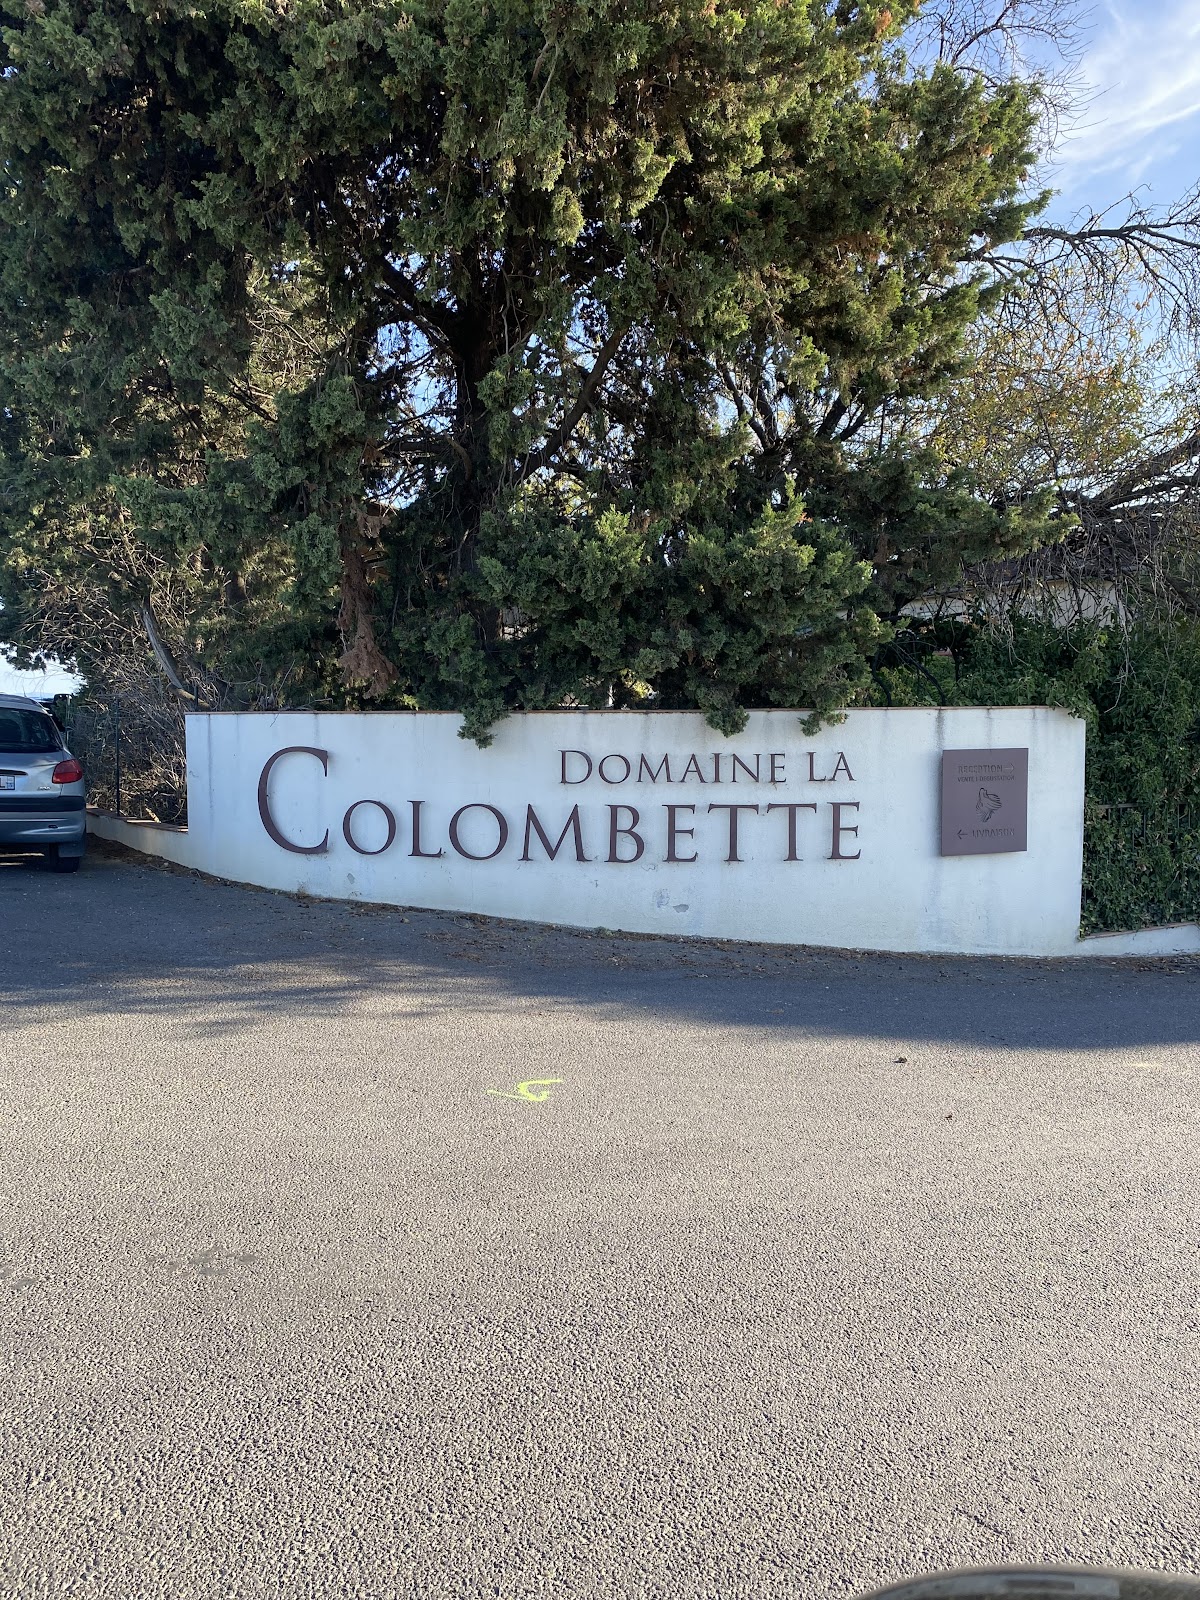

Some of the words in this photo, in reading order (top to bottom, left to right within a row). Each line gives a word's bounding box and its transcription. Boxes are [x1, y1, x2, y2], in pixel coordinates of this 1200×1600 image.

[558, 750, 787, 784] DOMAINE
[807, 752, 857, 782] LA
[958, 764, 1003, 774] RECEPTION
[257, 746, 861, 863] COLOMBETTE
